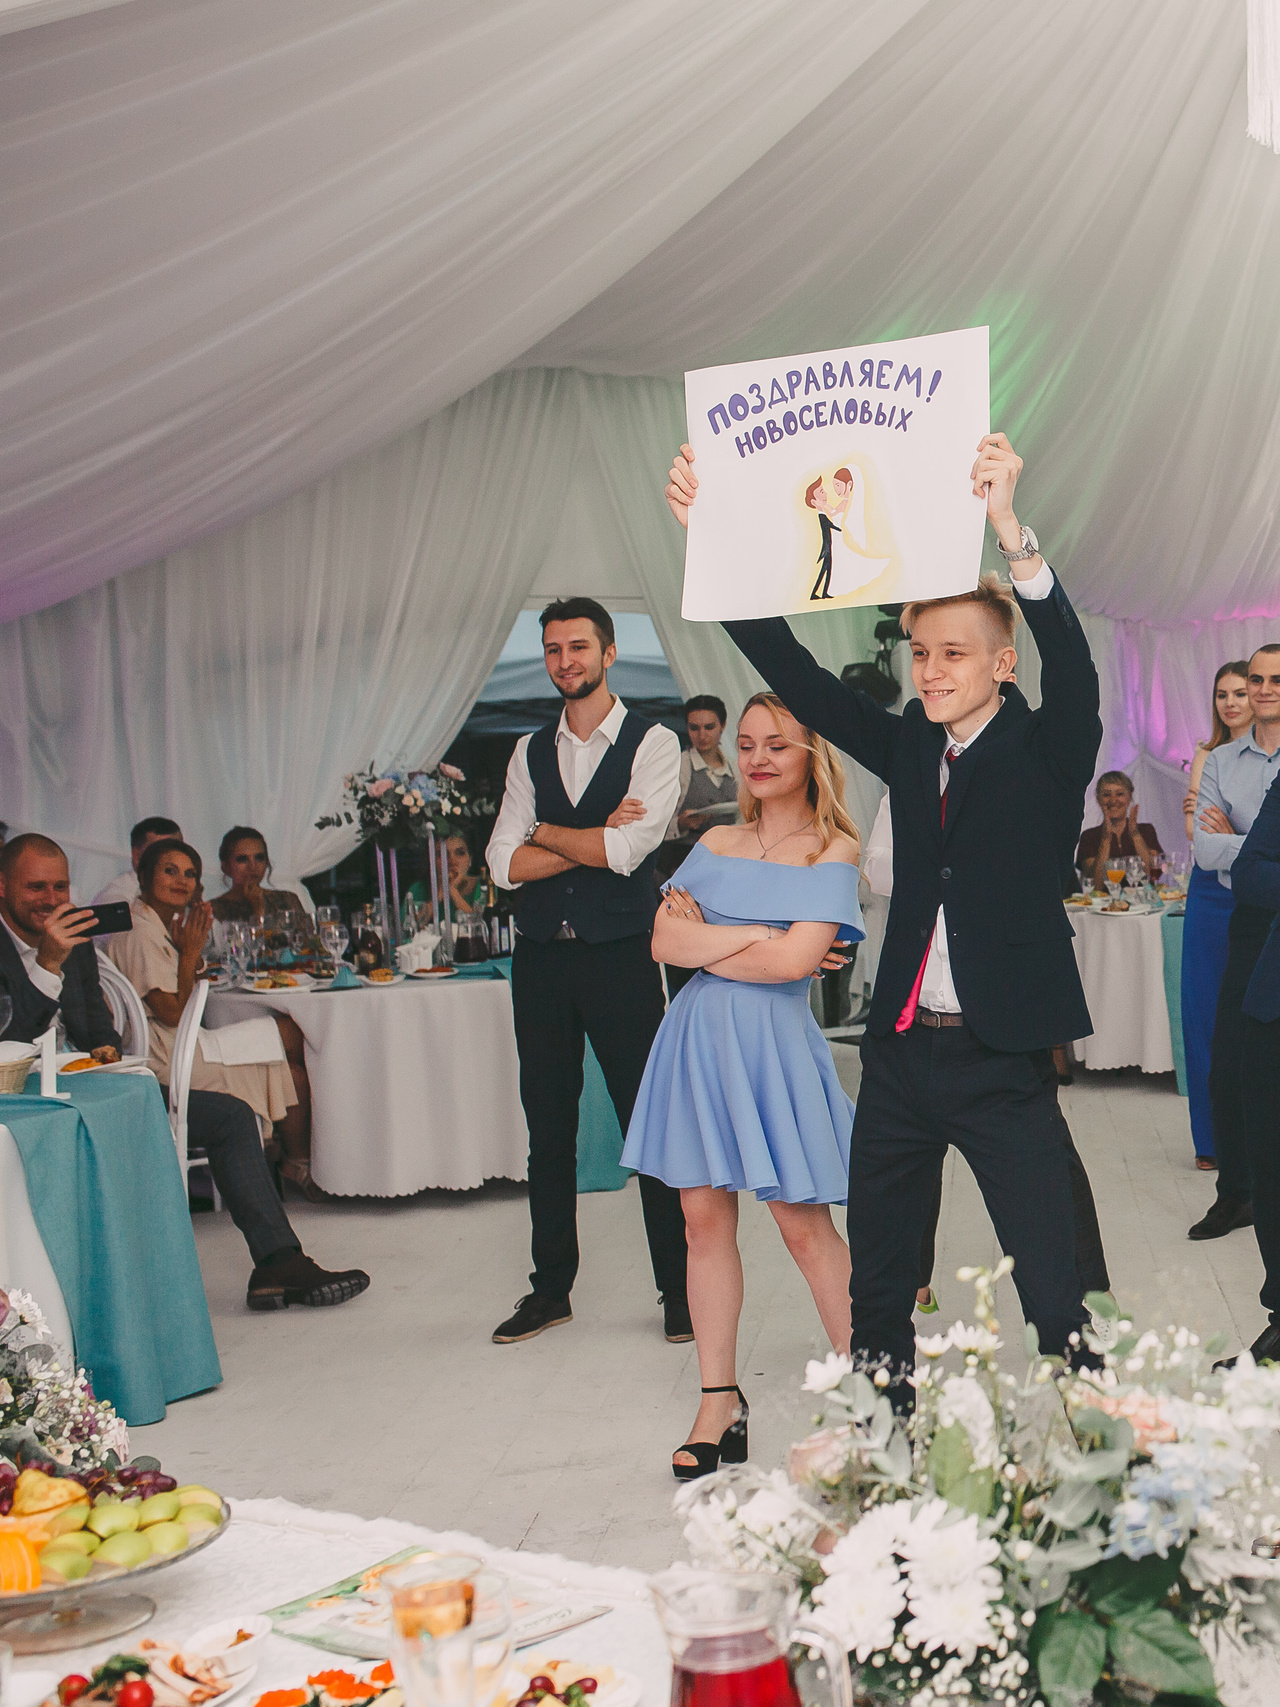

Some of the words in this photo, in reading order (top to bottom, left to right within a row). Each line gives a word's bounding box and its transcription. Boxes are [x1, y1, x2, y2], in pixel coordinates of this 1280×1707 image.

[706, 358, 942, 435] ПОЗДРАВЛЯЕМ!
[735, 398, 913, 459] НОВОСЕЛОВЫХ
[33, 1026, 71, 1100] 1
